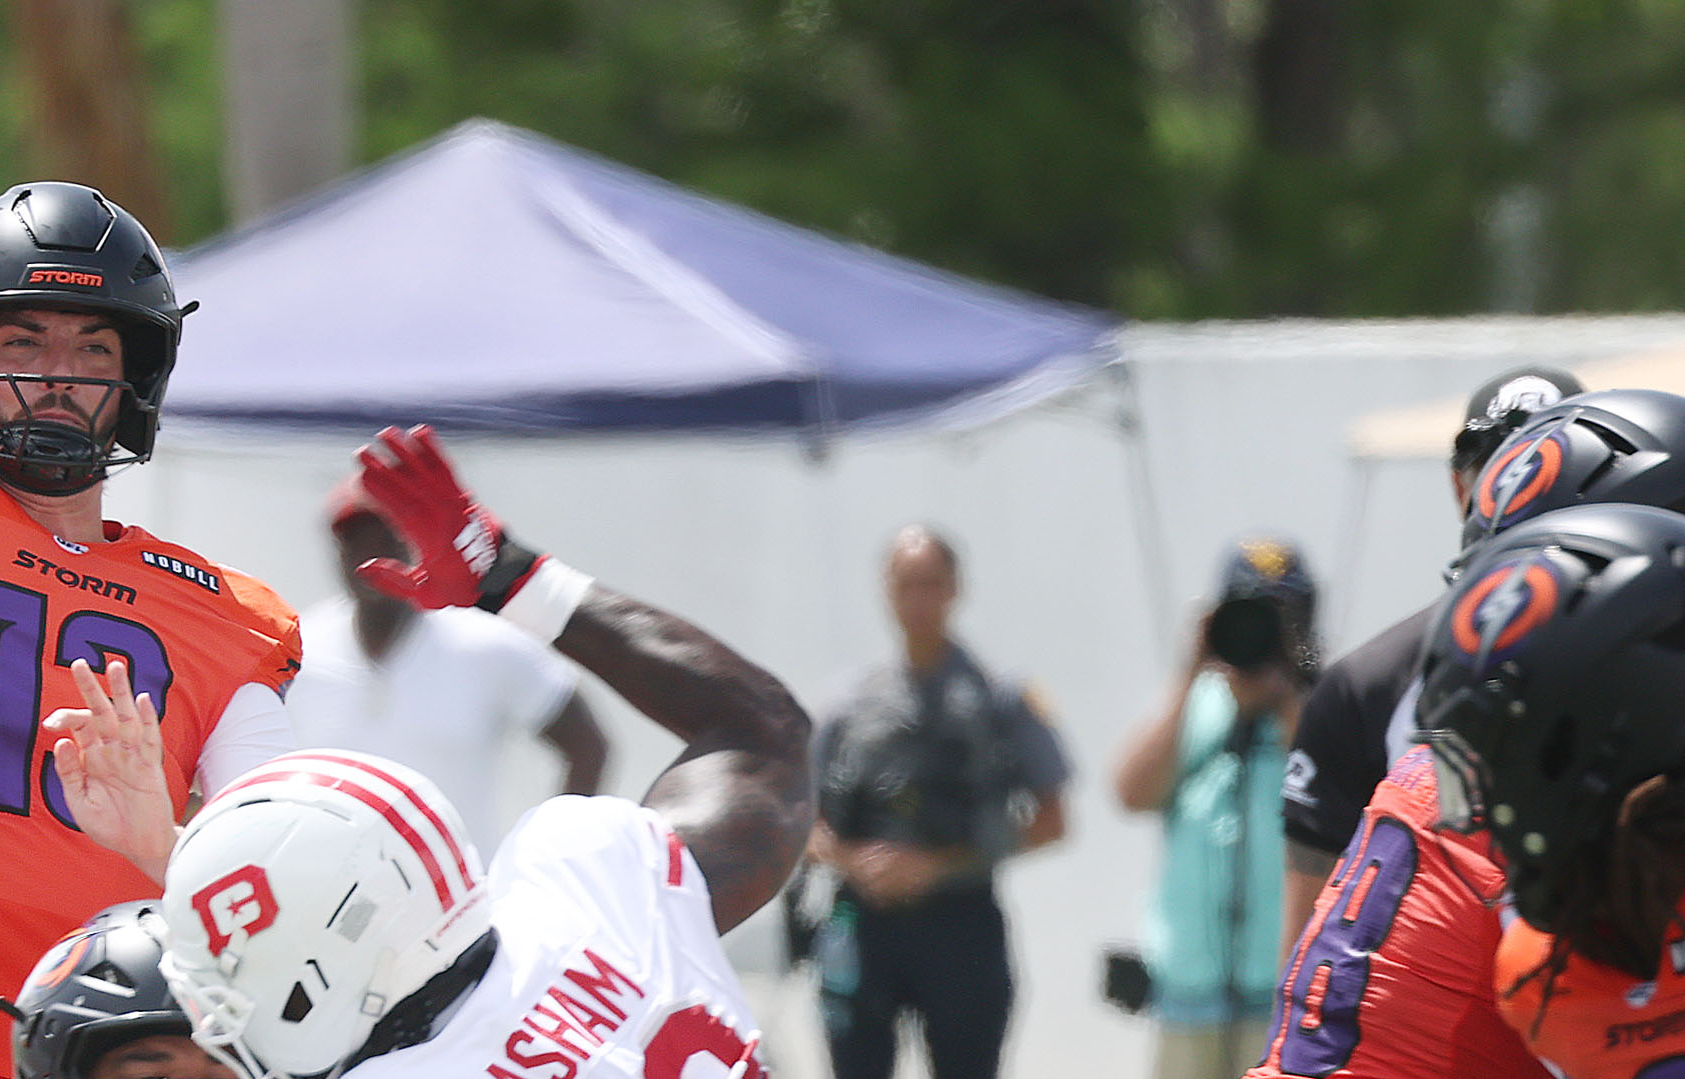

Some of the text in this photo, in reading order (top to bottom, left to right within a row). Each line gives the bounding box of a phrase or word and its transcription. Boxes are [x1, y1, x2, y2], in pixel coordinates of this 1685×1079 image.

[28, 270, 103, 288] STORM
[13, 549, 137, 606] STORM
[142, 551, 219, 591] NOBULL
